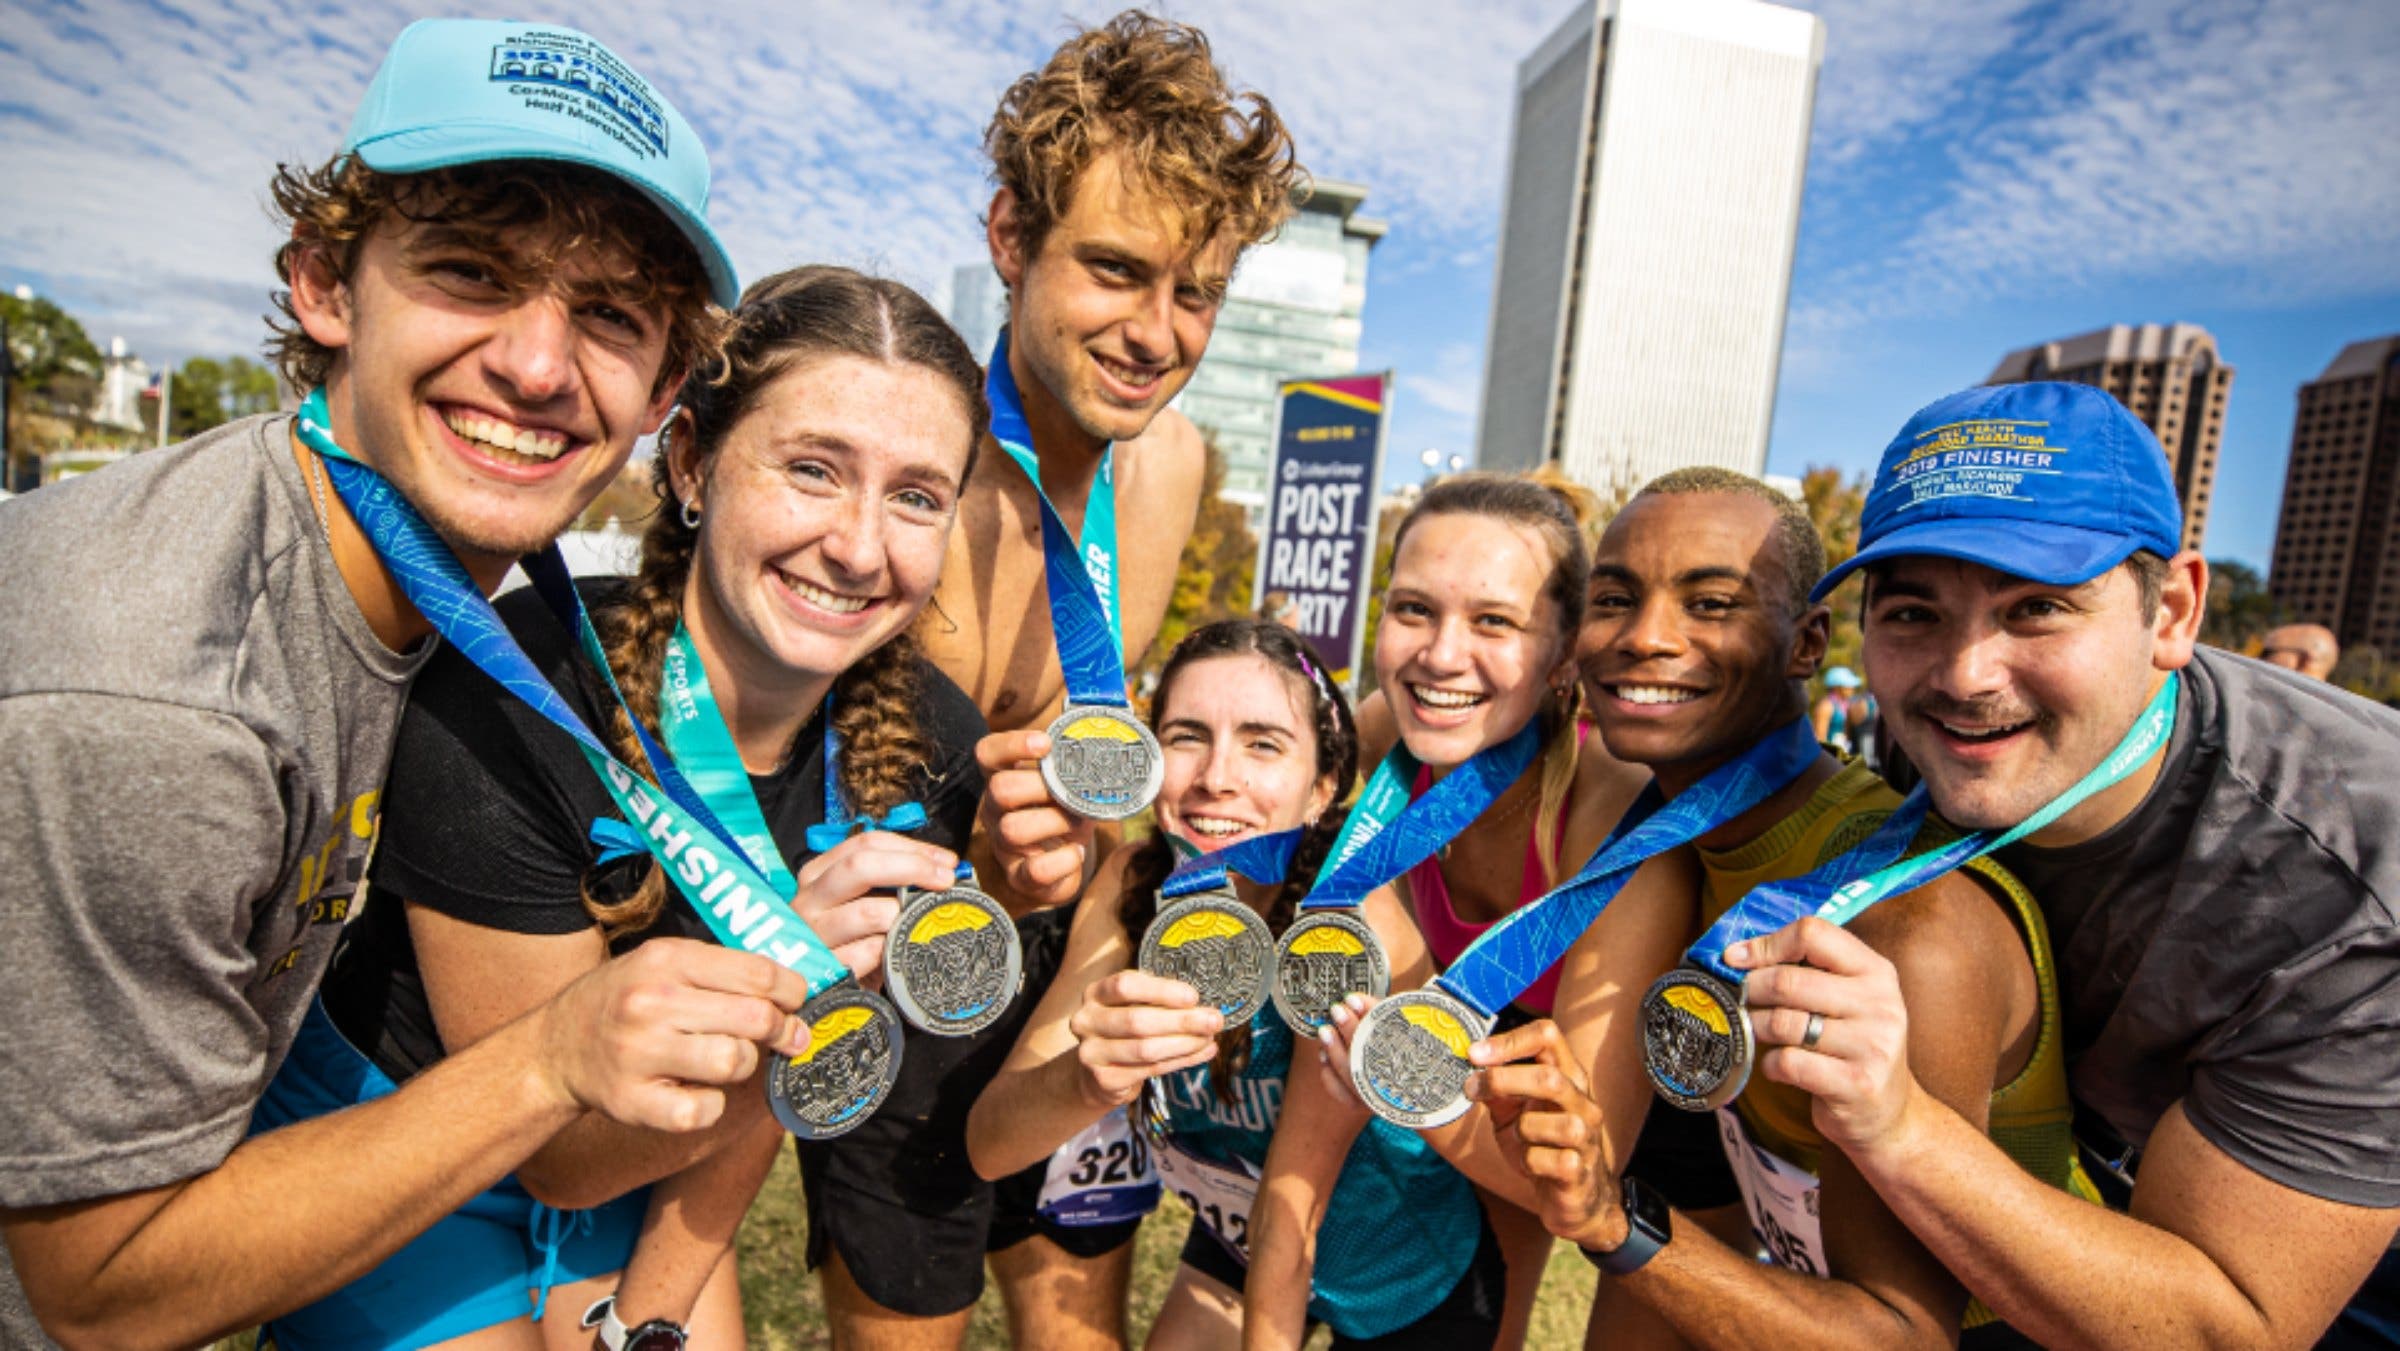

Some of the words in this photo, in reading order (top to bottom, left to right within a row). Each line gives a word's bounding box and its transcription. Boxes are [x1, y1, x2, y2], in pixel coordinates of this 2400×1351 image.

[508, 84, 582, 105] CarMax
[585, 97, 657, 158] Richmond
[525, 98, 564, 114] Half
[567, 106, 645, 160] Marathon
[1899, 456, 1938, 480] 2019
[1944, 450, 2053, 468] FINISHER
[1276, 482, 1363, 536] POST
[1270, 538, 1354, 592] RACE
[1288, 592, 1348, 638] RTY
